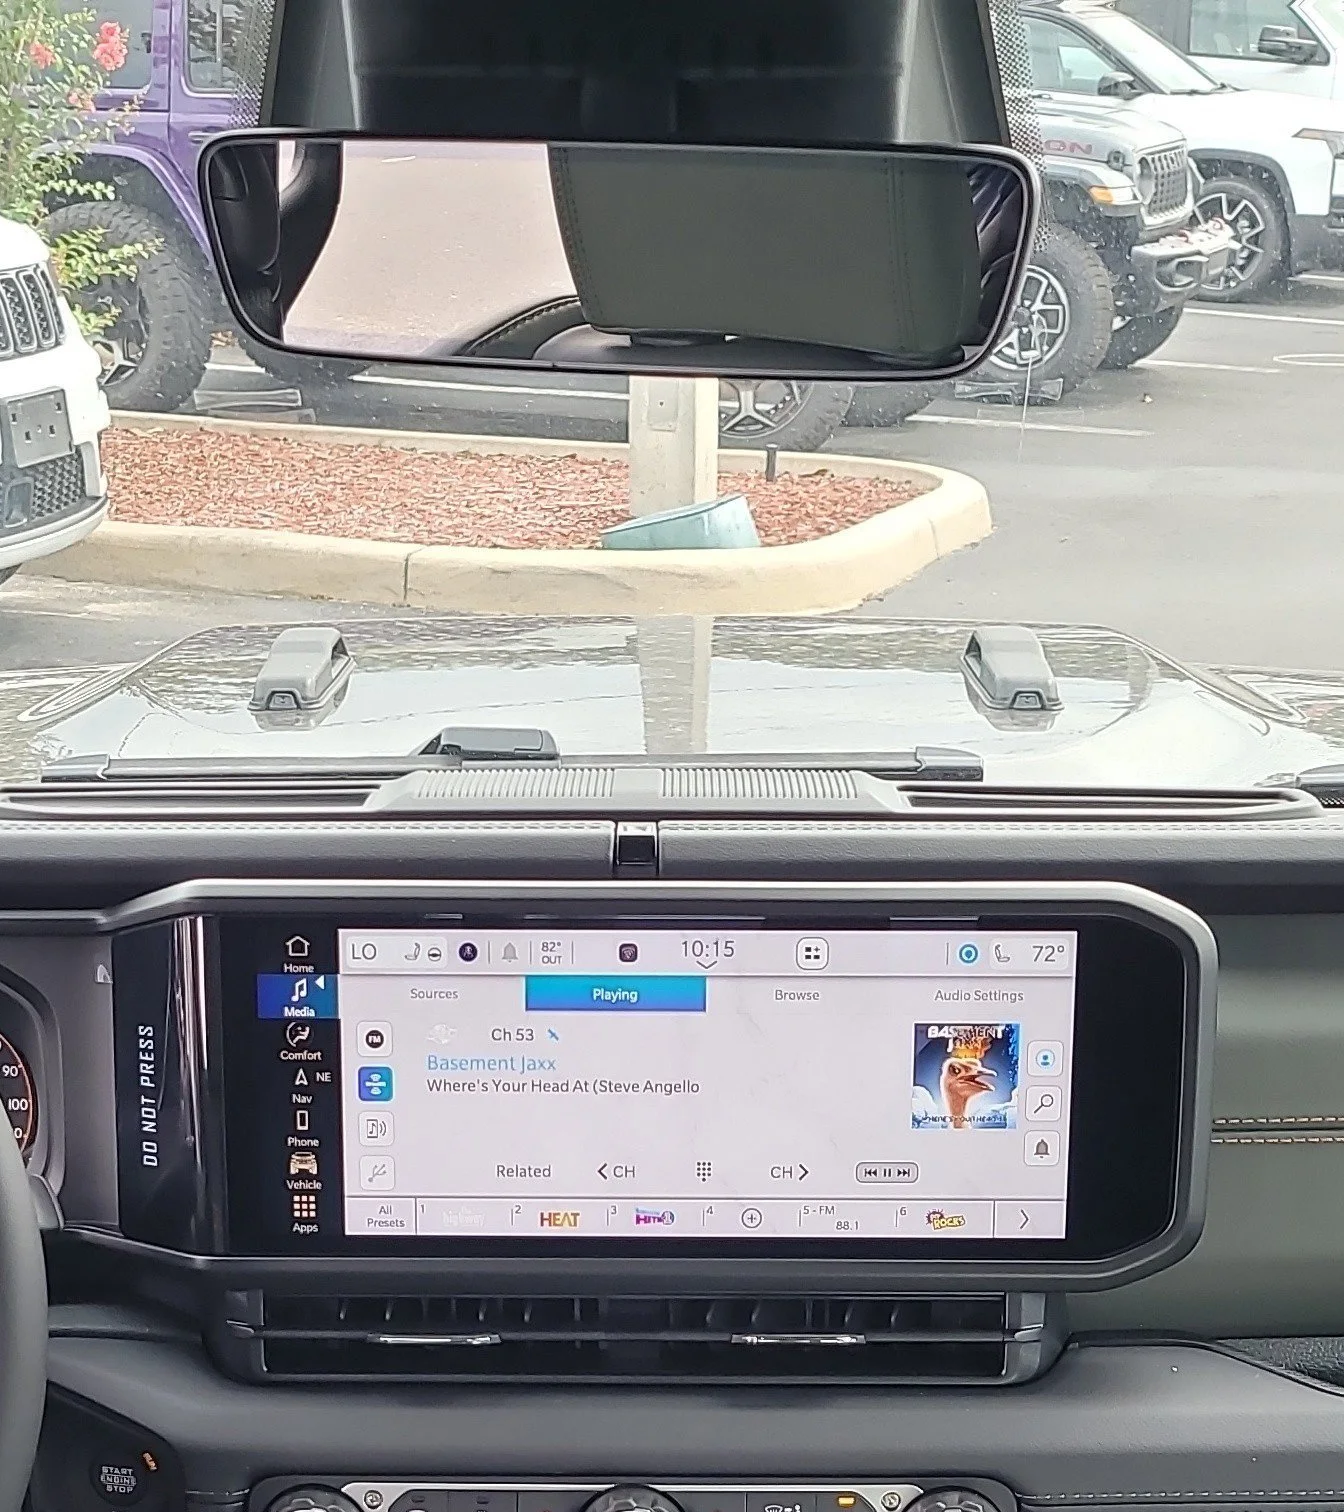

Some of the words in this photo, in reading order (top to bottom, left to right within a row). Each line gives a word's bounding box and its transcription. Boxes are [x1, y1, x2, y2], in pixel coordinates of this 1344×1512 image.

[351, 943, 377, 960] LO
[541, 941, 562, 952] 82°
[681, 940, 735, 959] 10:15
[1031, 944, 1066, 963] 72°
[541, 955, 562, 965] OUT
[284, 963, 314, 973] Home
[410, 987, 458, 1000] Sources
[593, 987, 638, 1002] Playing
[774, 988, 821, 1001] Browse
[934, 988, 971, 1001] Audio
[973, 988, 1025, 1005] Settings
[284, 1006, 315, 1017] Media
[491, 1028, 512, 1042] Ch
[515, 1028, 534, 1041] 53
[138, 1025, 155, 1088] PRESS
[280, 1050, 322, 1060] Comfort
[427, 1055, 516, 1071] Basement
[518, 1055, 556, 1074] Jaxx
[2, 1065, 18, 1077] 90
[316, 1072, 332, 1082] NE
[426, 1078, 488, 1093] Where's
[491, 1078, 528, 1093] Your
[531, 1078, 569, 1093] Head
[572, 1079, 589, 1093] At
[593, 1079, 640, 1095] (Steve
[642, 1079, 700, 1098] Angello
[292, 1094, 312, 1103] Nav
[8, 1099, 28, 1111] 100
[141, 1095, 156, 1133] NOT
[287, 1136, 319, 1147] Phone
[142, 1141, 158, 1167] DO
[495, 1163, 552, 1179] Related
[612, 1164, 637, 1178] CH
[770, 1166, 794, 1180] CH
[286, 1179, 322, 1190] Vehicle
[378, 1205, 392, 1215] All
[515, 1205, 522, 1214] 2
[610, 1205, 617, 1214] 3
[706, 1205, 713, 1214] 4
[803, 1206, 810, 1215] 5
[819, 1206, 835, 1215] FM
[900, 1206, 907, 1216] 6
[367, 1218, 405, 1228] Presets
[540, 1211, 580, 1227] HEAT
[932, 1214, 966, 1230] ROCKS
[292, 1223, 318, 1233] Apps
[836, 1221, 859, 1231] 88.1
[101, 1466, 134, 1476] START
[100, 1475, 137, 1486] ENGINE
[106, 1485, 134, 1494] STOP
